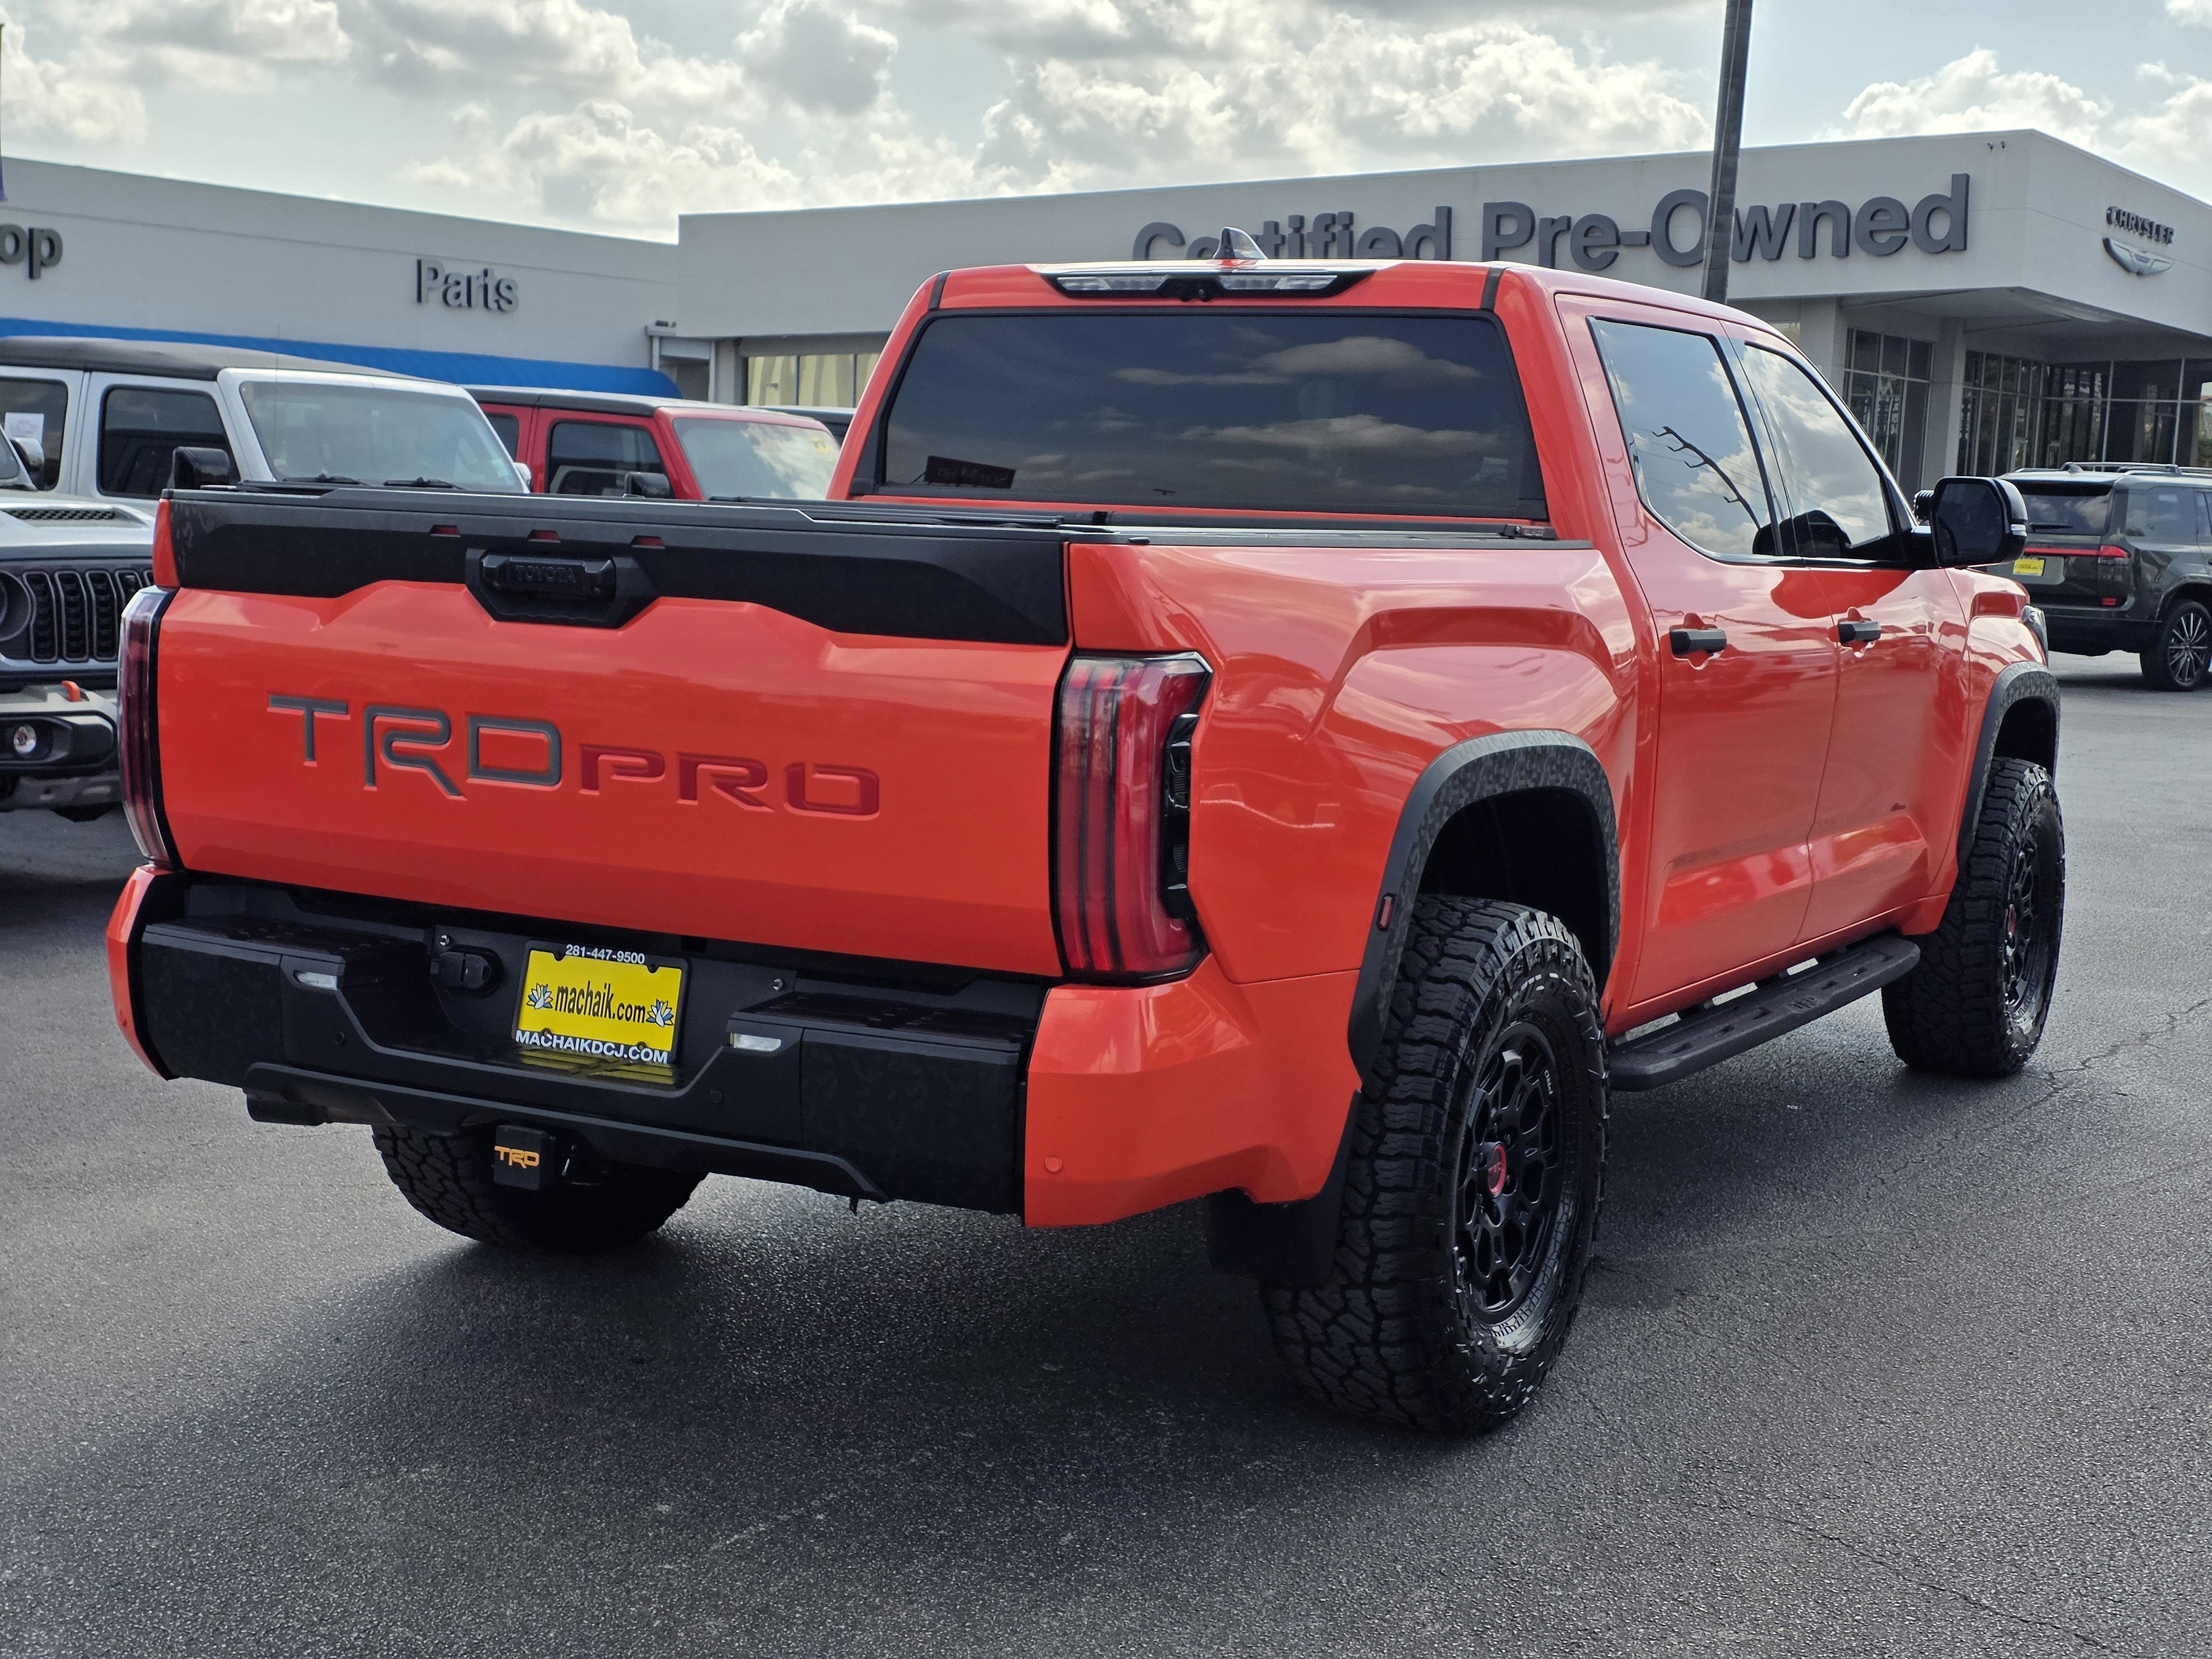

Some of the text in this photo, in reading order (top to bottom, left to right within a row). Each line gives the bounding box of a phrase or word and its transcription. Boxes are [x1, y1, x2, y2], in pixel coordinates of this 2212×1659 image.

[2106, 205, 2174, 244] CHRYSLER
[416, 258, 519, 313] Parts
[515, 565, 577, 583] TOYOTA
[267, 693, 880, 820] TRD PRO
[565, 943, 645, 964] 281-447-9500
[555, 980, 646, 1023] machaik.com
[515, 1029, 668, 1064] MACHAIKDCJ.COM
[494, 1145, 540, 1168] TRD
